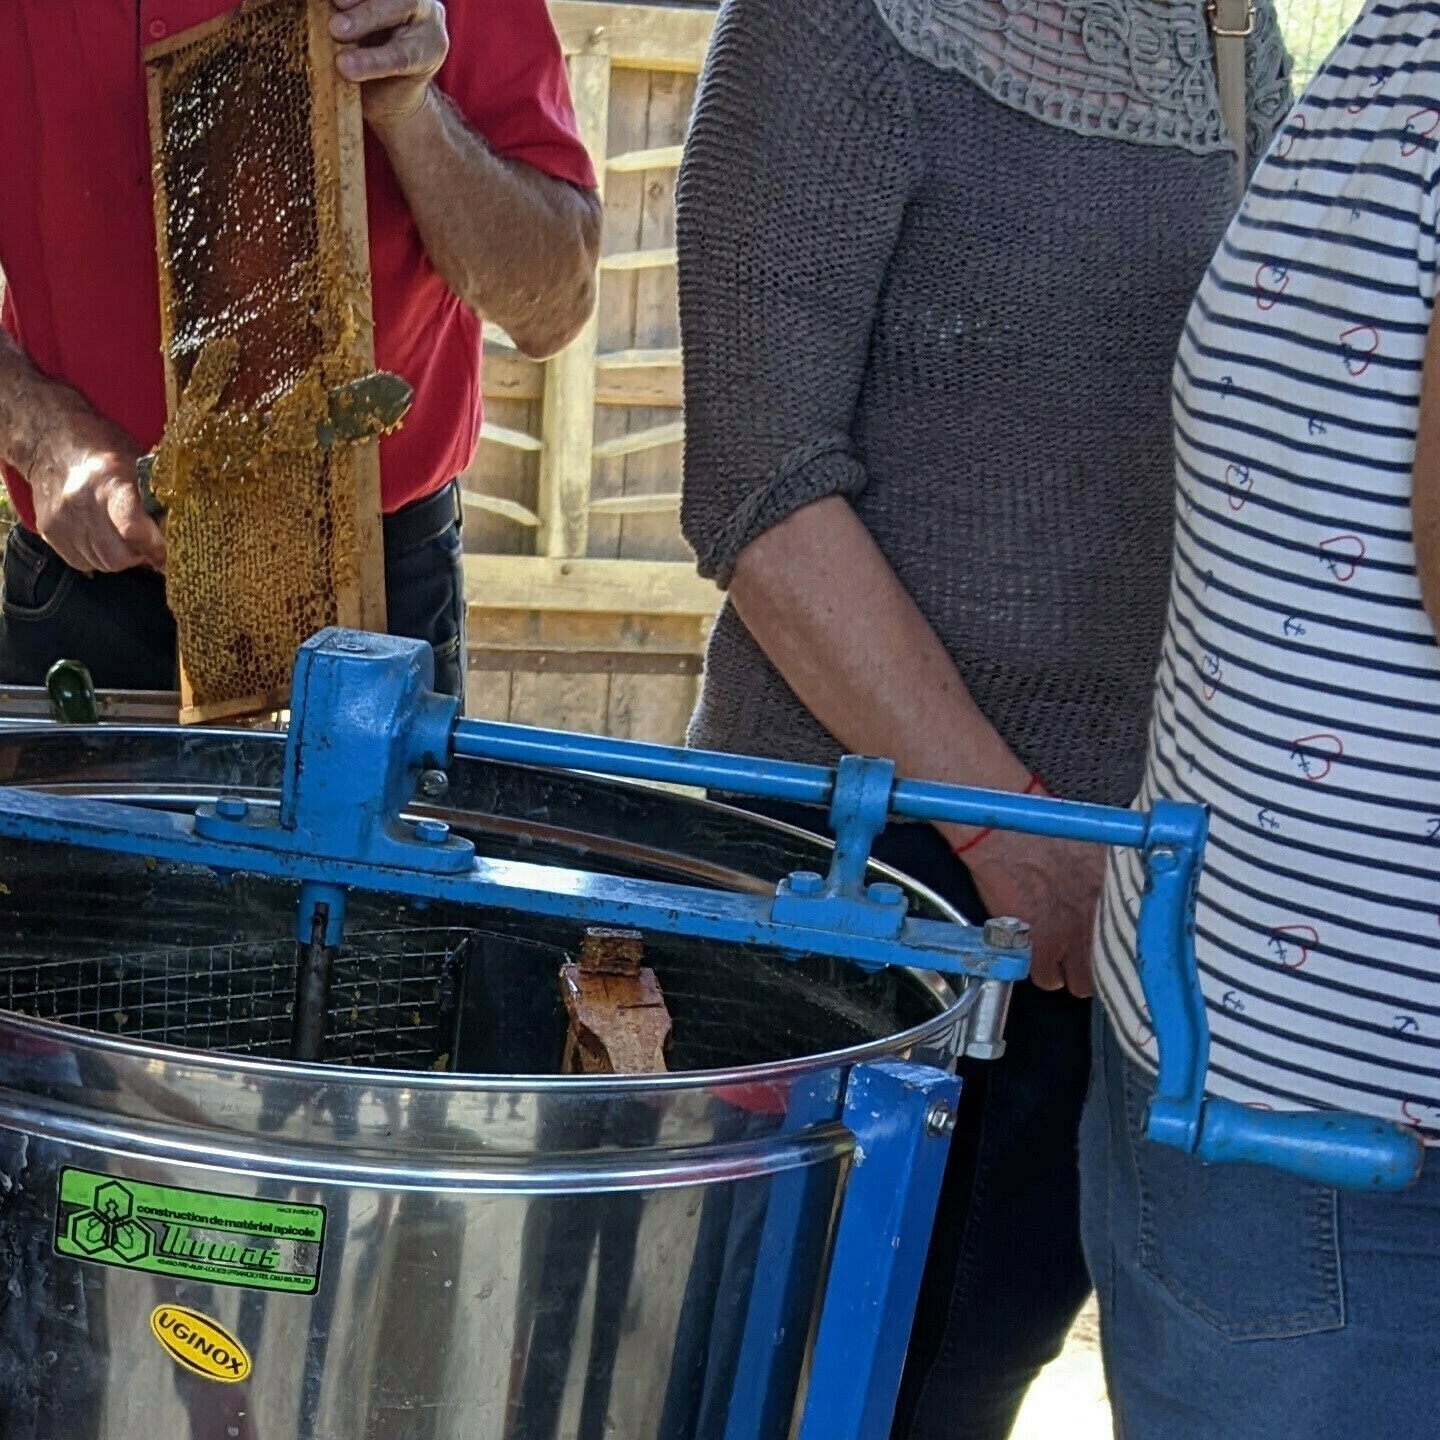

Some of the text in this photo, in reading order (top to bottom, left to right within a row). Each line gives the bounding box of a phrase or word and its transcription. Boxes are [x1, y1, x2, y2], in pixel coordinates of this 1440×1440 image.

[136, 1205, 316, 1238] construction de matériel apicole
[160, 1223, 280, 1269] Thomas
[158, 1312, 244, 1376] UGINOX
